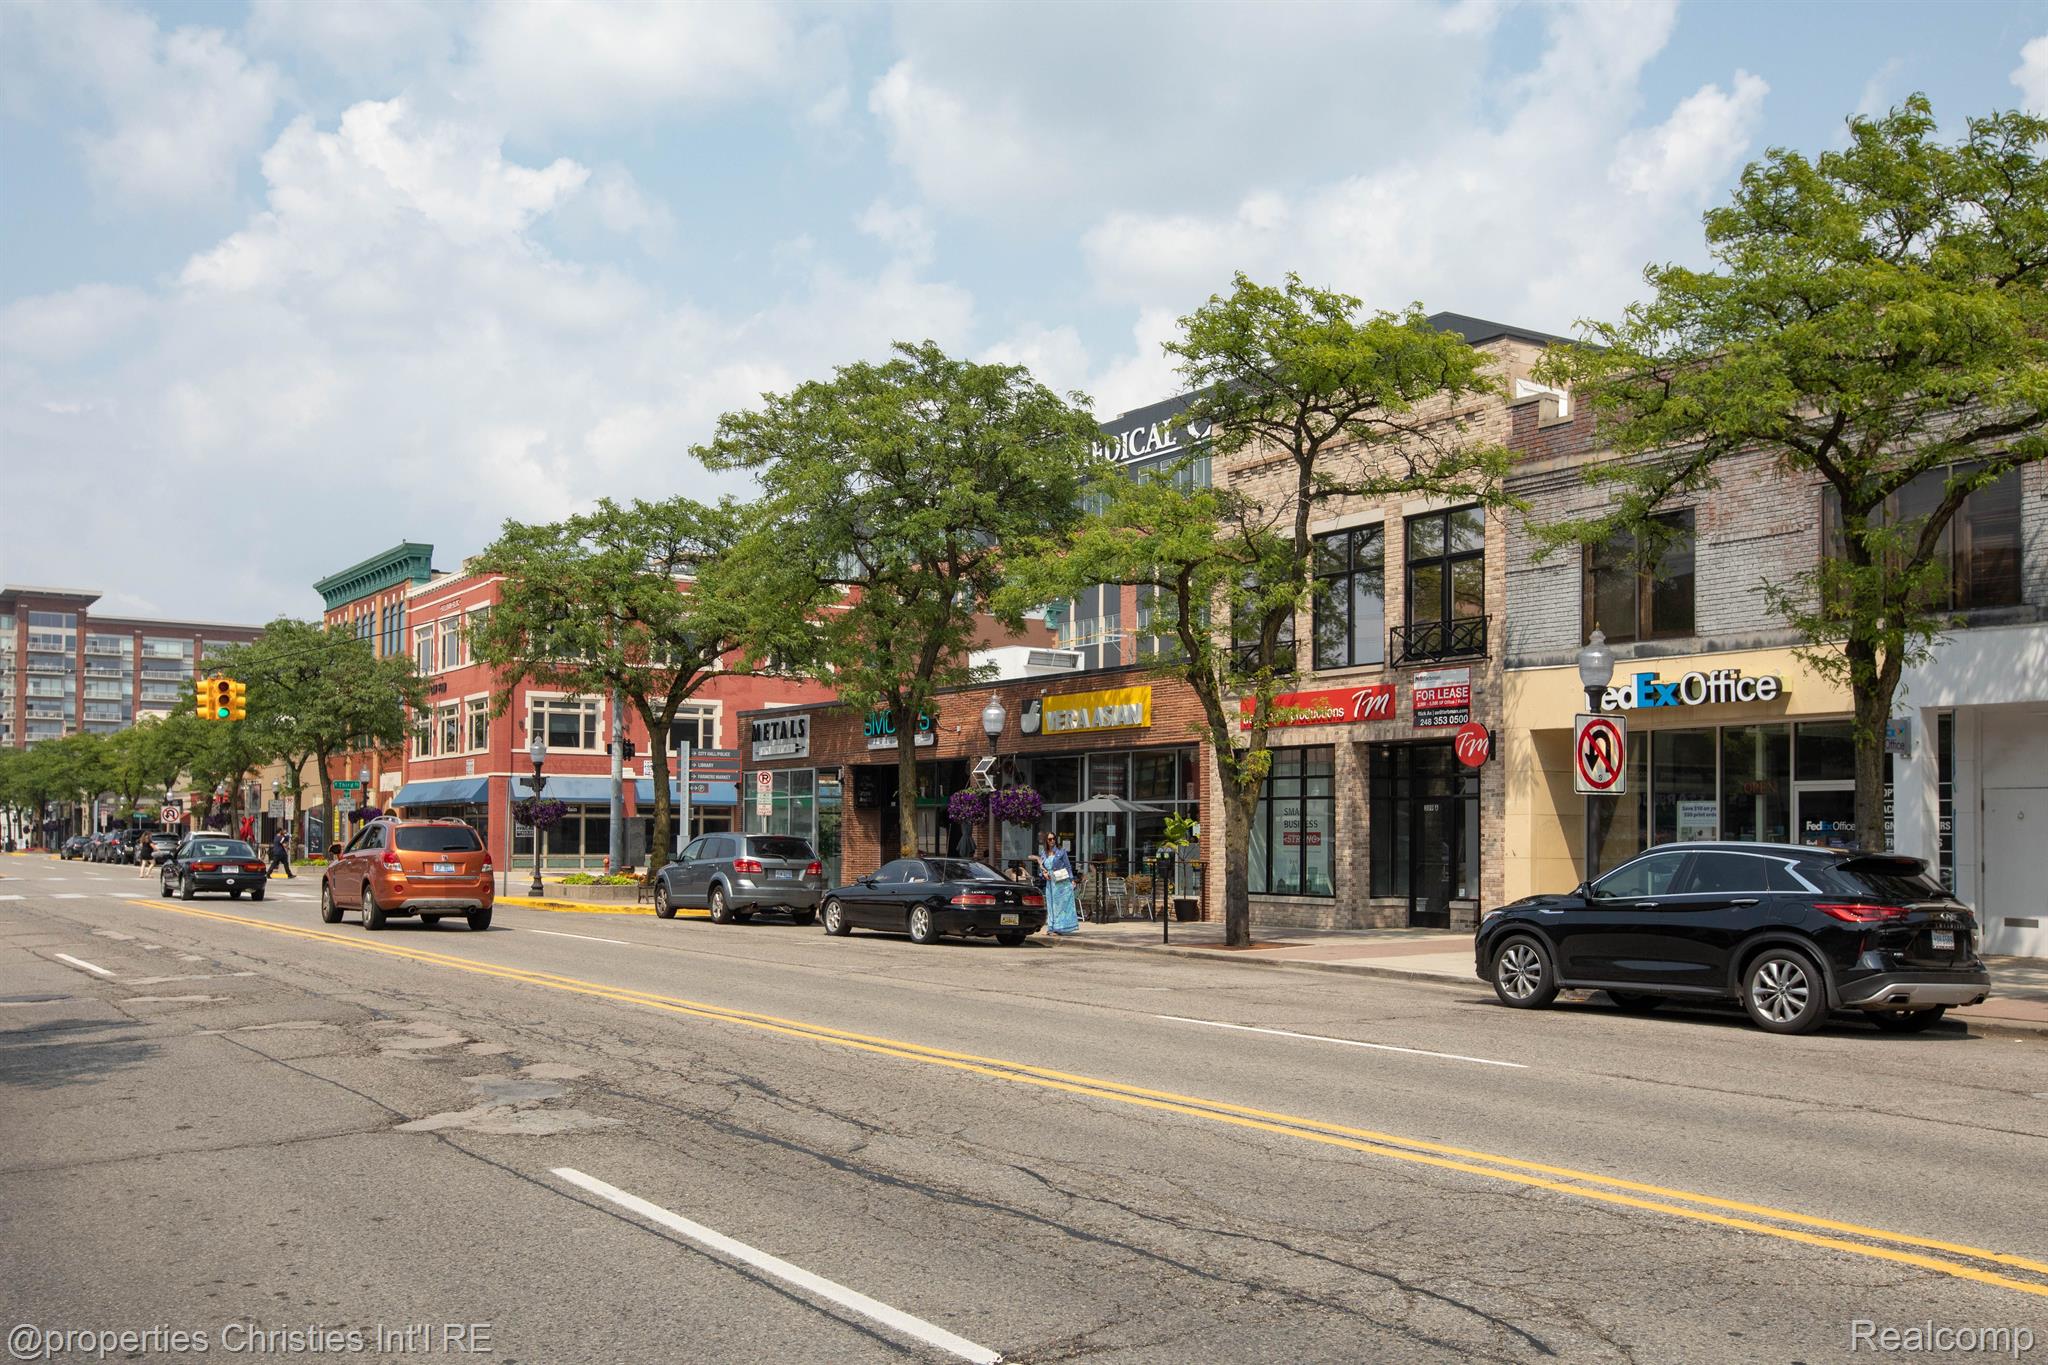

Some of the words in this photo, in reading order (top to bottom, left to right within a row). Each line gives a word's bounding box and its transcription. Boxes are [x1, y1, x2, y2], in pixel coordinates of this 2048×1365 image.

[1416, 690, 1435, 701] FOR
[1437, 687, 1469, 699] LEASE
[1680, 669, 1778, 706] Office
[1092, 702, 1143, 728] ASIAN
[1420, 718, 1432, 726] 248
[1433, 716, 1448, 725] 353
[1449, 715, 1468, 724] 0500
[752, 718, 805, 742] METALS
[1283, 819, 1319, 829] BUSIESS
[1806, 821, 1832, 831] FedEx
[1832, 821, 1856, 831] Office
